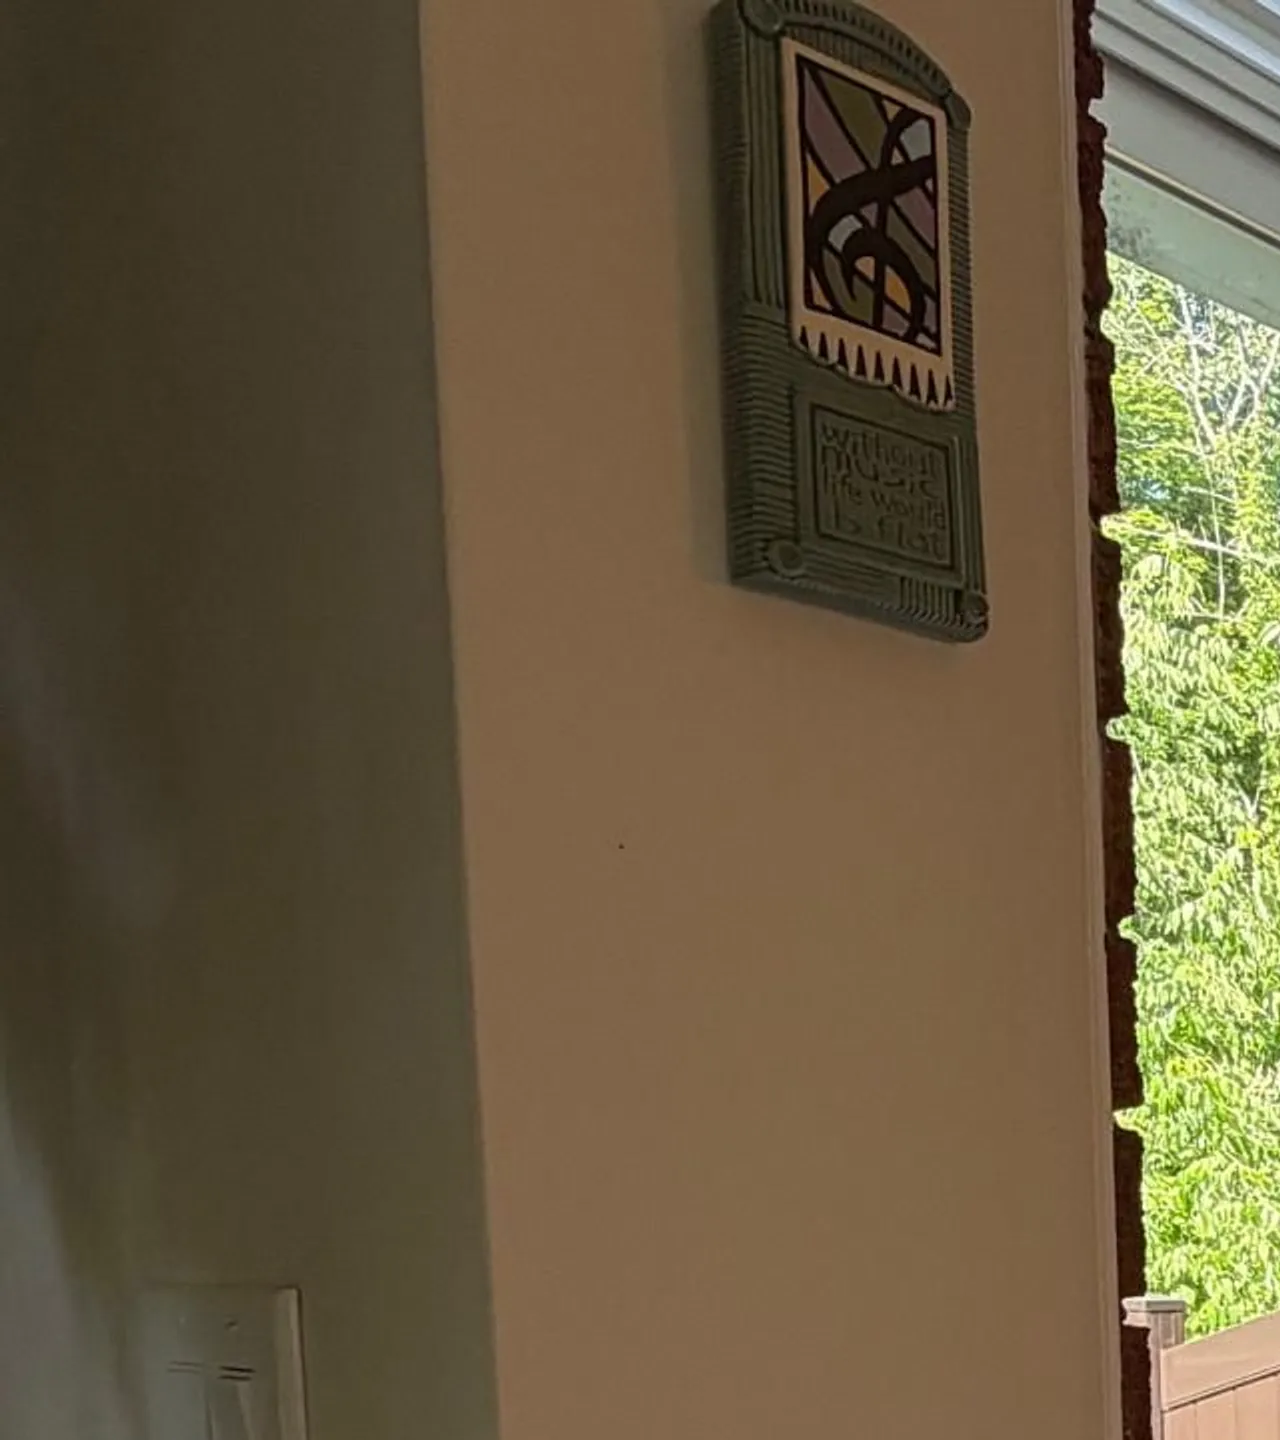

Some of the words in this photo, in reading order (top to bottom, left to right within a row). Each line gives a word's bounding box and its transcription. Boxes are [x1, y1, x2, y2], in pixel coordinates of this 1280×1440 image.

[820, 444, 939, 500] music
[821, 421, 944, 480] without
[823, 464, 864, 506] life
[869, 488, 947, 531] would
[876, 513, 947, 561] flat
